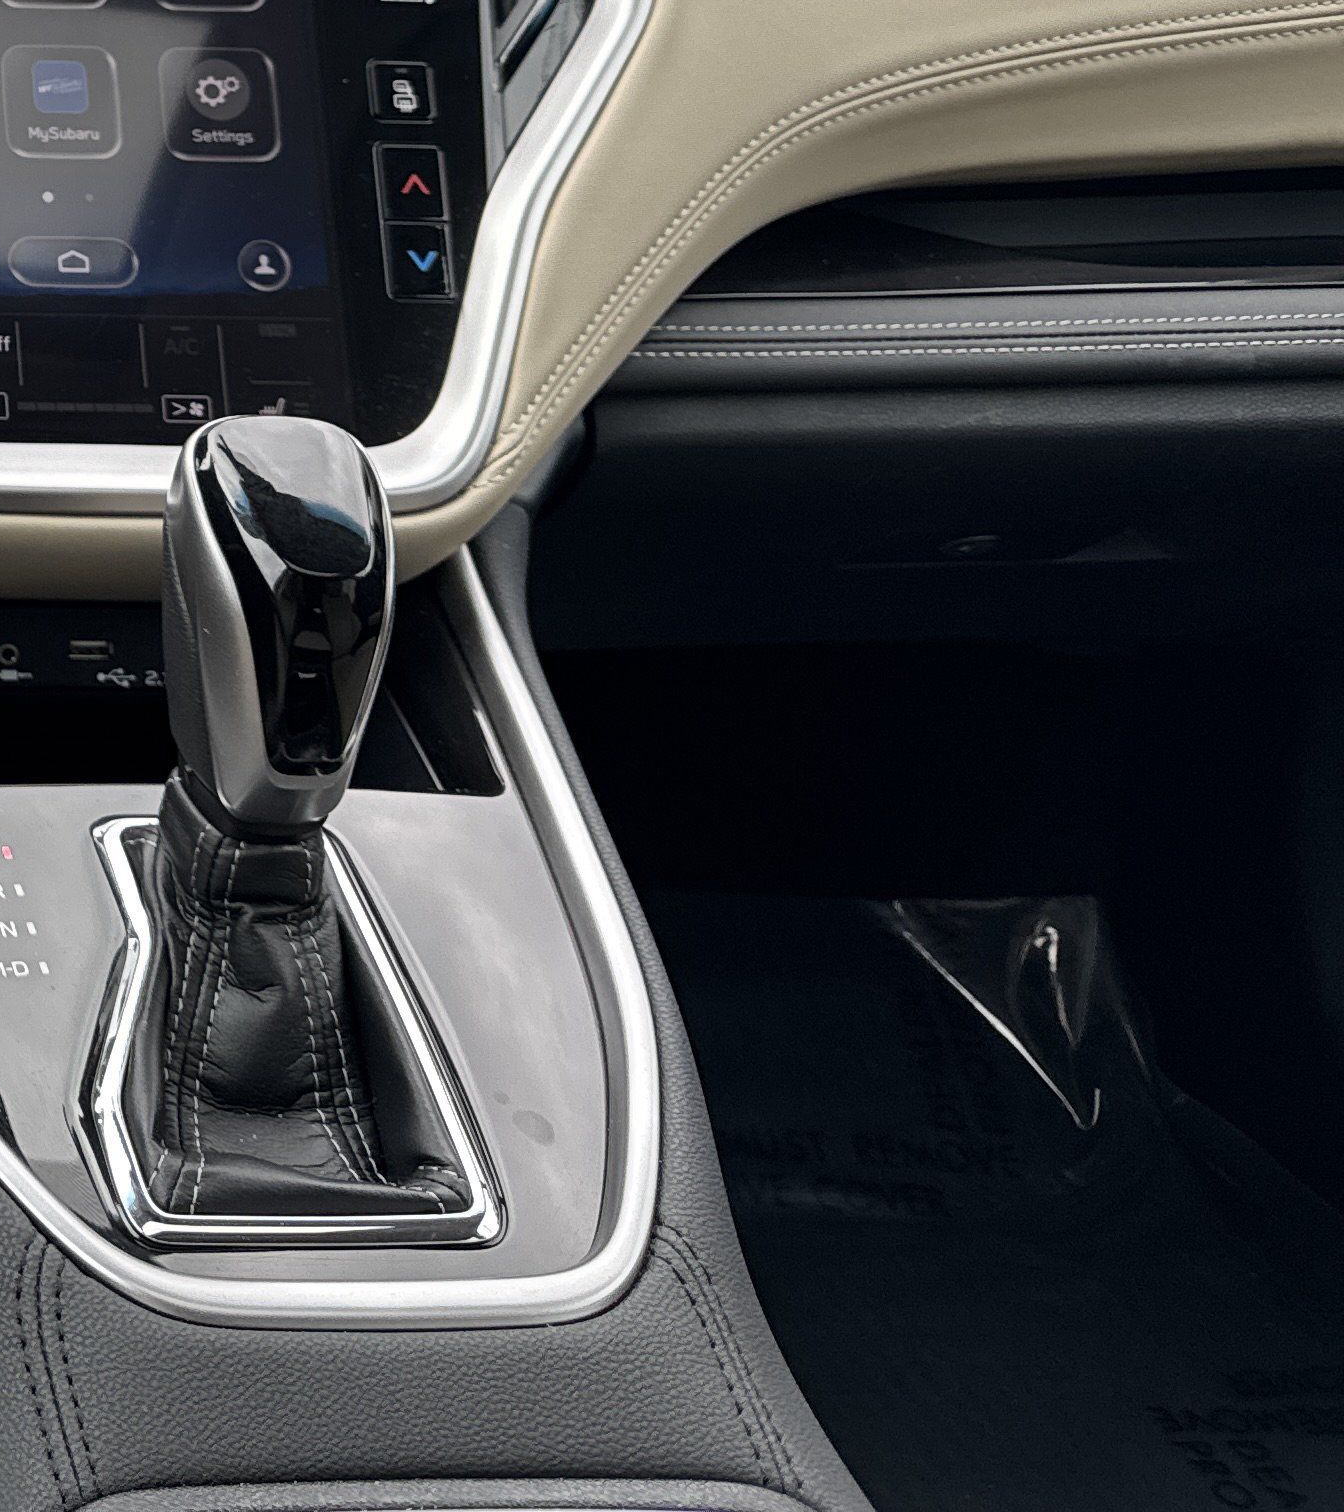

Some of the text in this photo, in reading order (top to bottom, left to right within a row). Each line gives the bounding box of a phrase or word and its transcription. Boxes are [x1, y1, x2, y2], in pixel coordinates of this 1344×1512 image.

[27, 126, 100, 143] MySubaru
[192, 128, 254, 146] Settings
[164, 338, 199, 356] A/C
[0, 920, 18, 938] N
